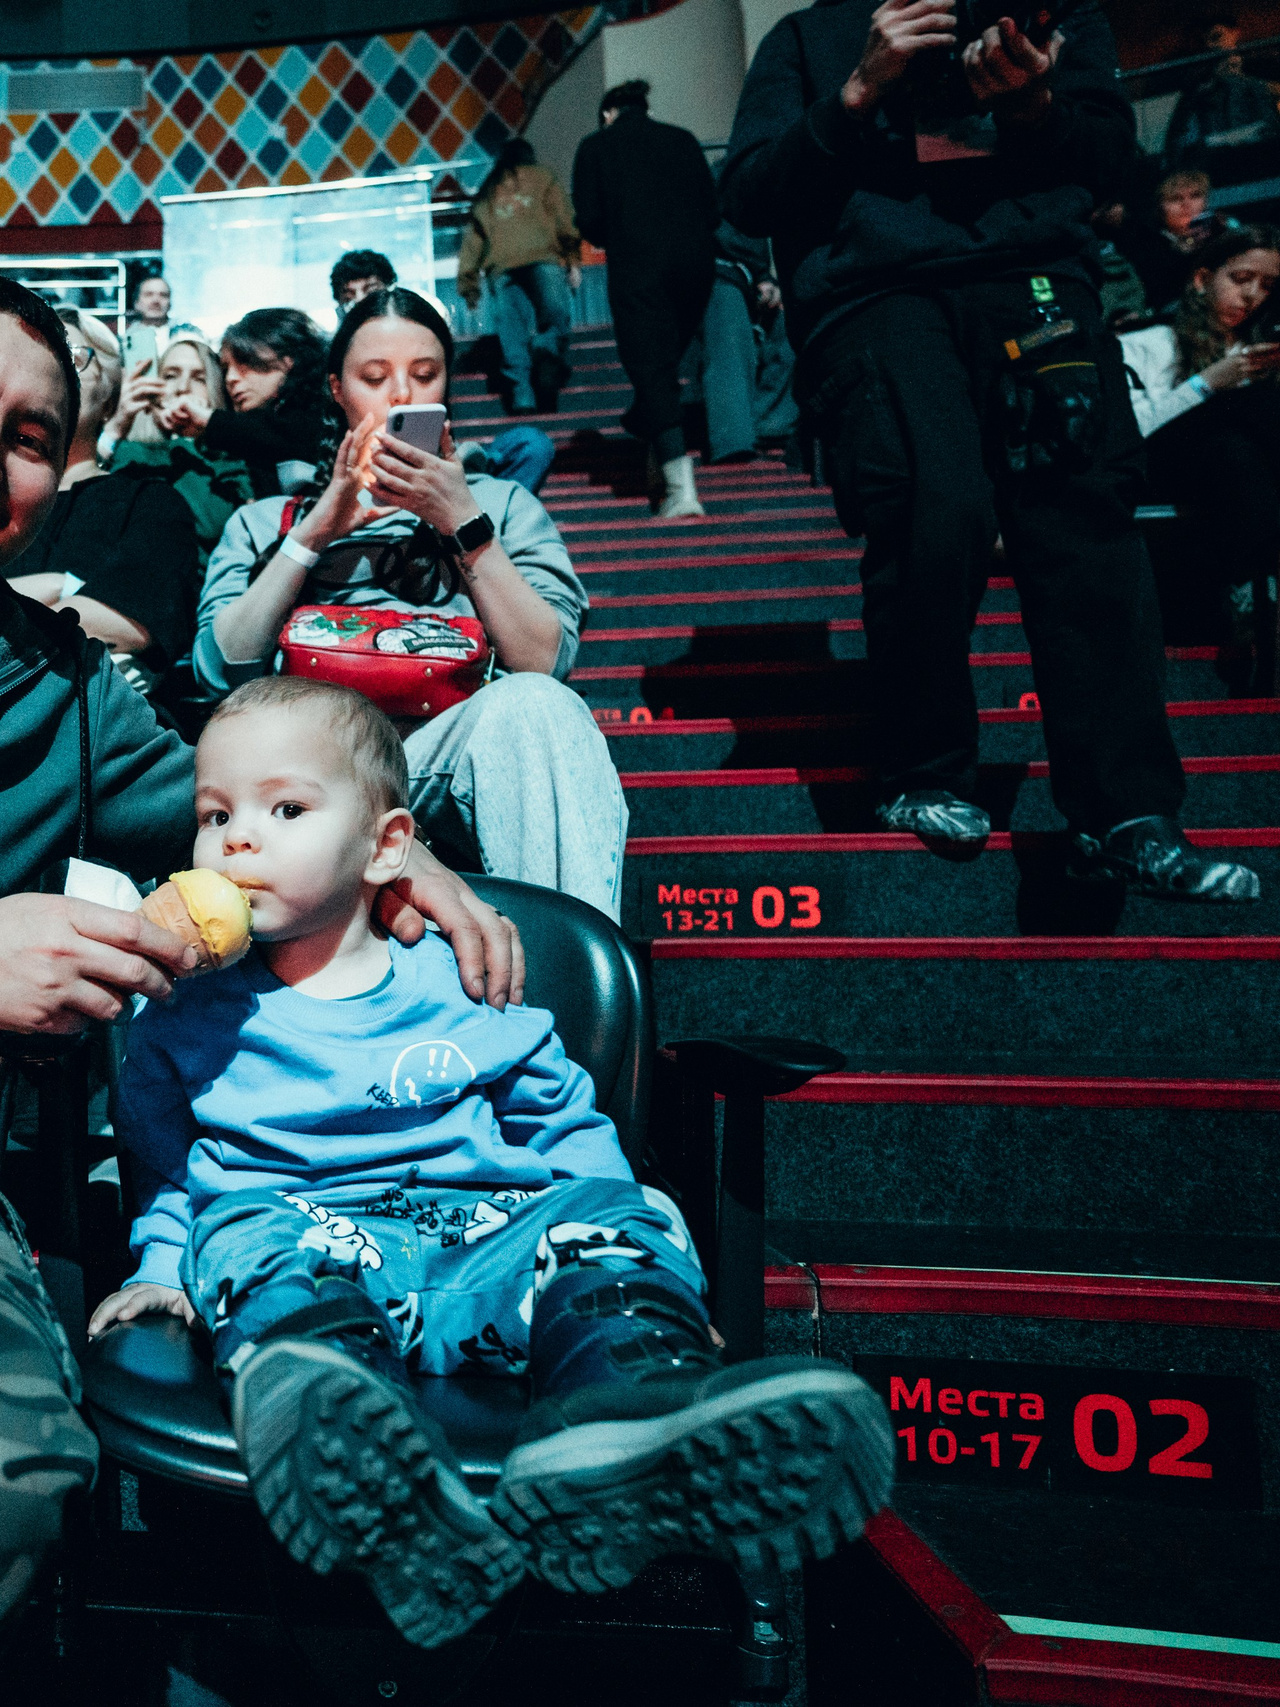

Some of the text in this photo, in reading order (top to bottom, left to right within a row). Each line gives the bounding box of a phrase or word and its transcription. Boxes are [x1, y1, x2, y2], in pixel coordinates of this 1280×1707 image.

[658, 884, 821, 928] Места 03
[662, 910, 733, 931] 13-21
[890, 1376, 1213, 1479] Места 02
[897, 1426, 1042, 1470] 10-17
